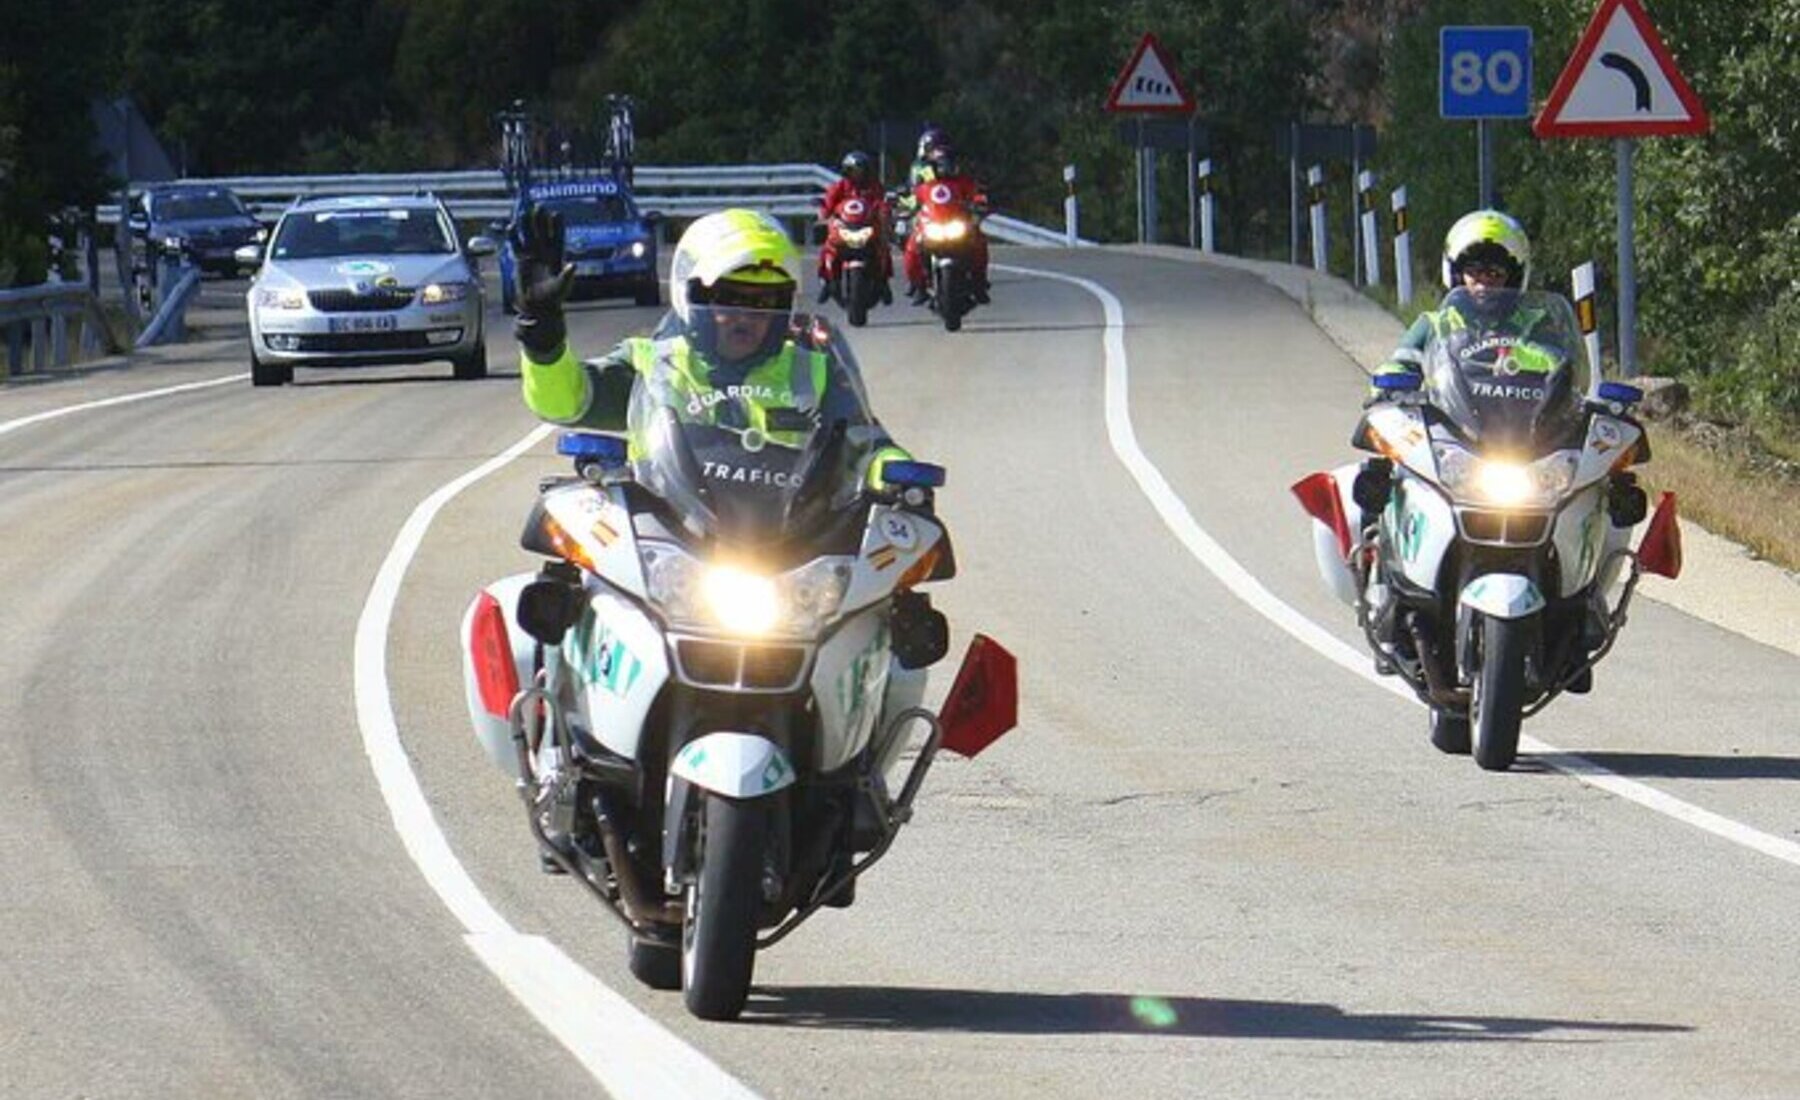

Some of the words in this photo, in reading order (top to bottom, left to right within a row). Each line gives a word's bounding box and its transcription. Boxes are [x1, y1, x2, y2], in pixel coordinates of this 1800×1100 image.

[1450, 50, 1523, 96] 80
[529, 181, 618, 199] SHIMANO
[686, 385, 773, 415] GUARDIA
[1472, 382, 1545, 400] TRAFICO
[703, 461, 804, 488] TRAFICO
